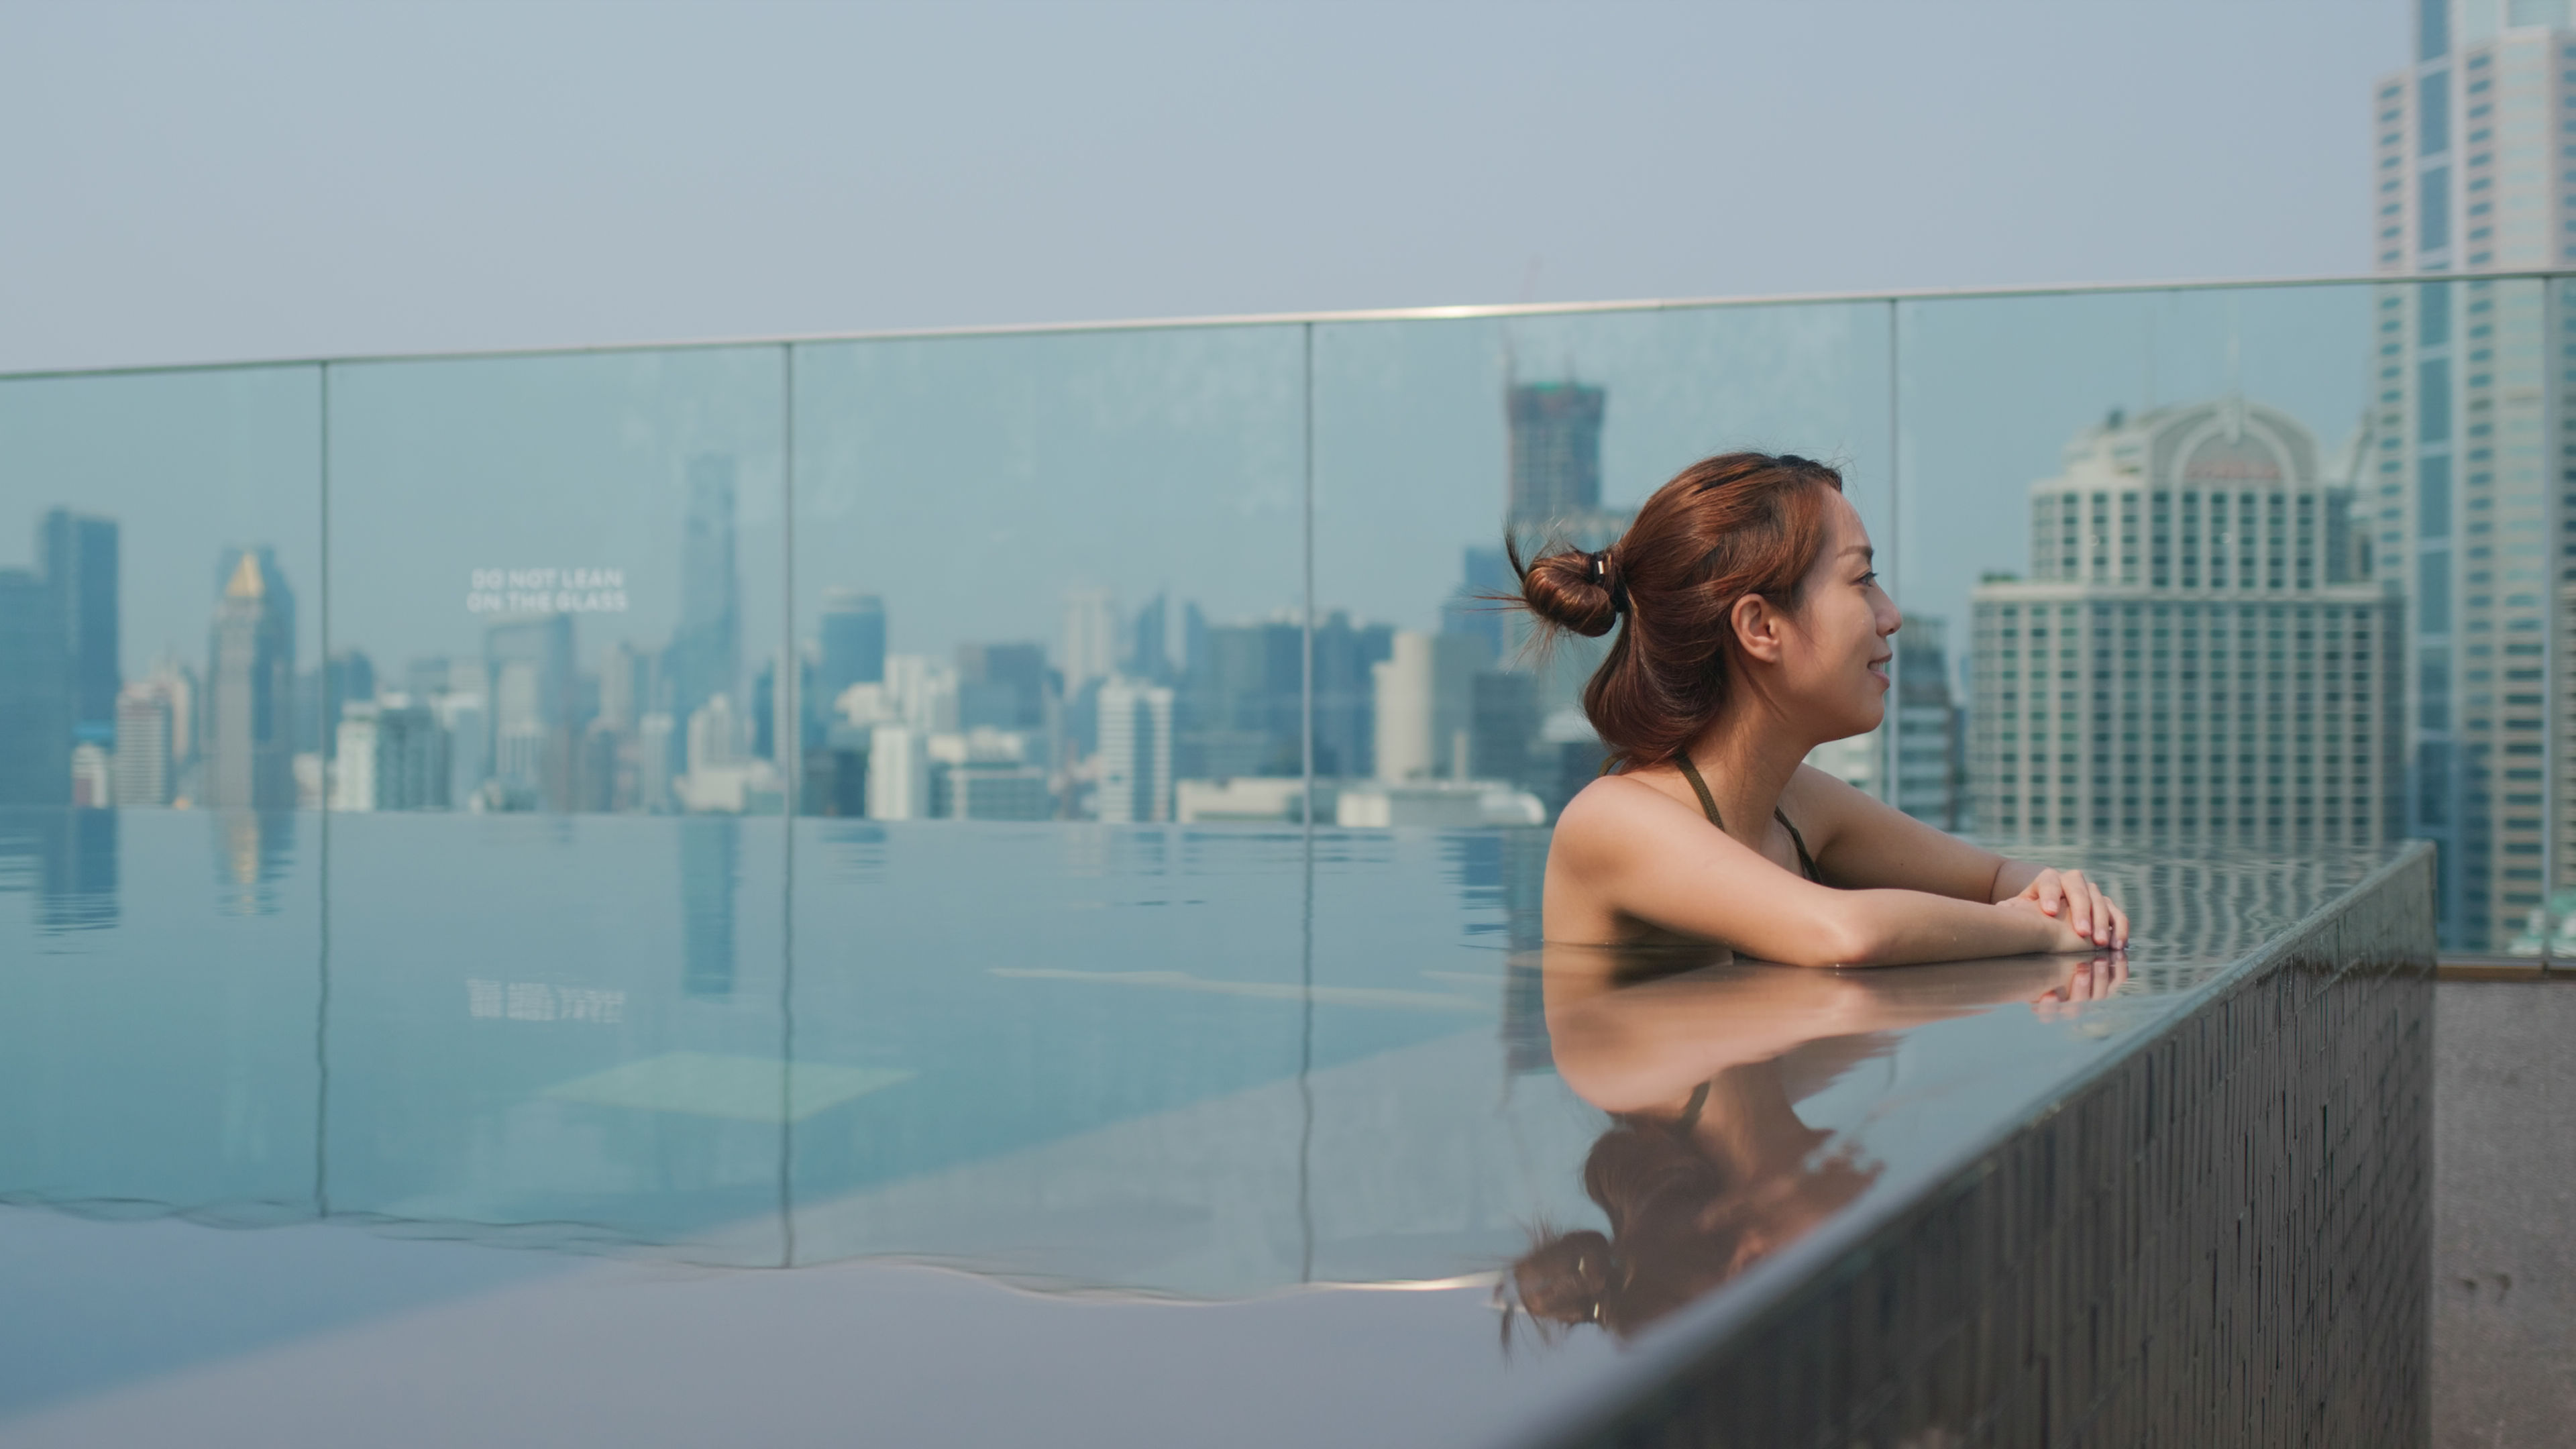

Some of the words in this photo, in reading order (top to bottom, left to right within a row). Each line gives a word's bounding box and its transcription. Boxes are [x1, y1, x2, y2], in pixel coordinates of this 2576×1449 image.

[472, 568, 503, 590] DO
[508, 568, 556, 589] NOT
[561, 568, 624, 588] LEAN
[468, 591, 502, 612] ON
[507, 590, 551, 611] THE
[555, 590, 628, 611] GLASS
